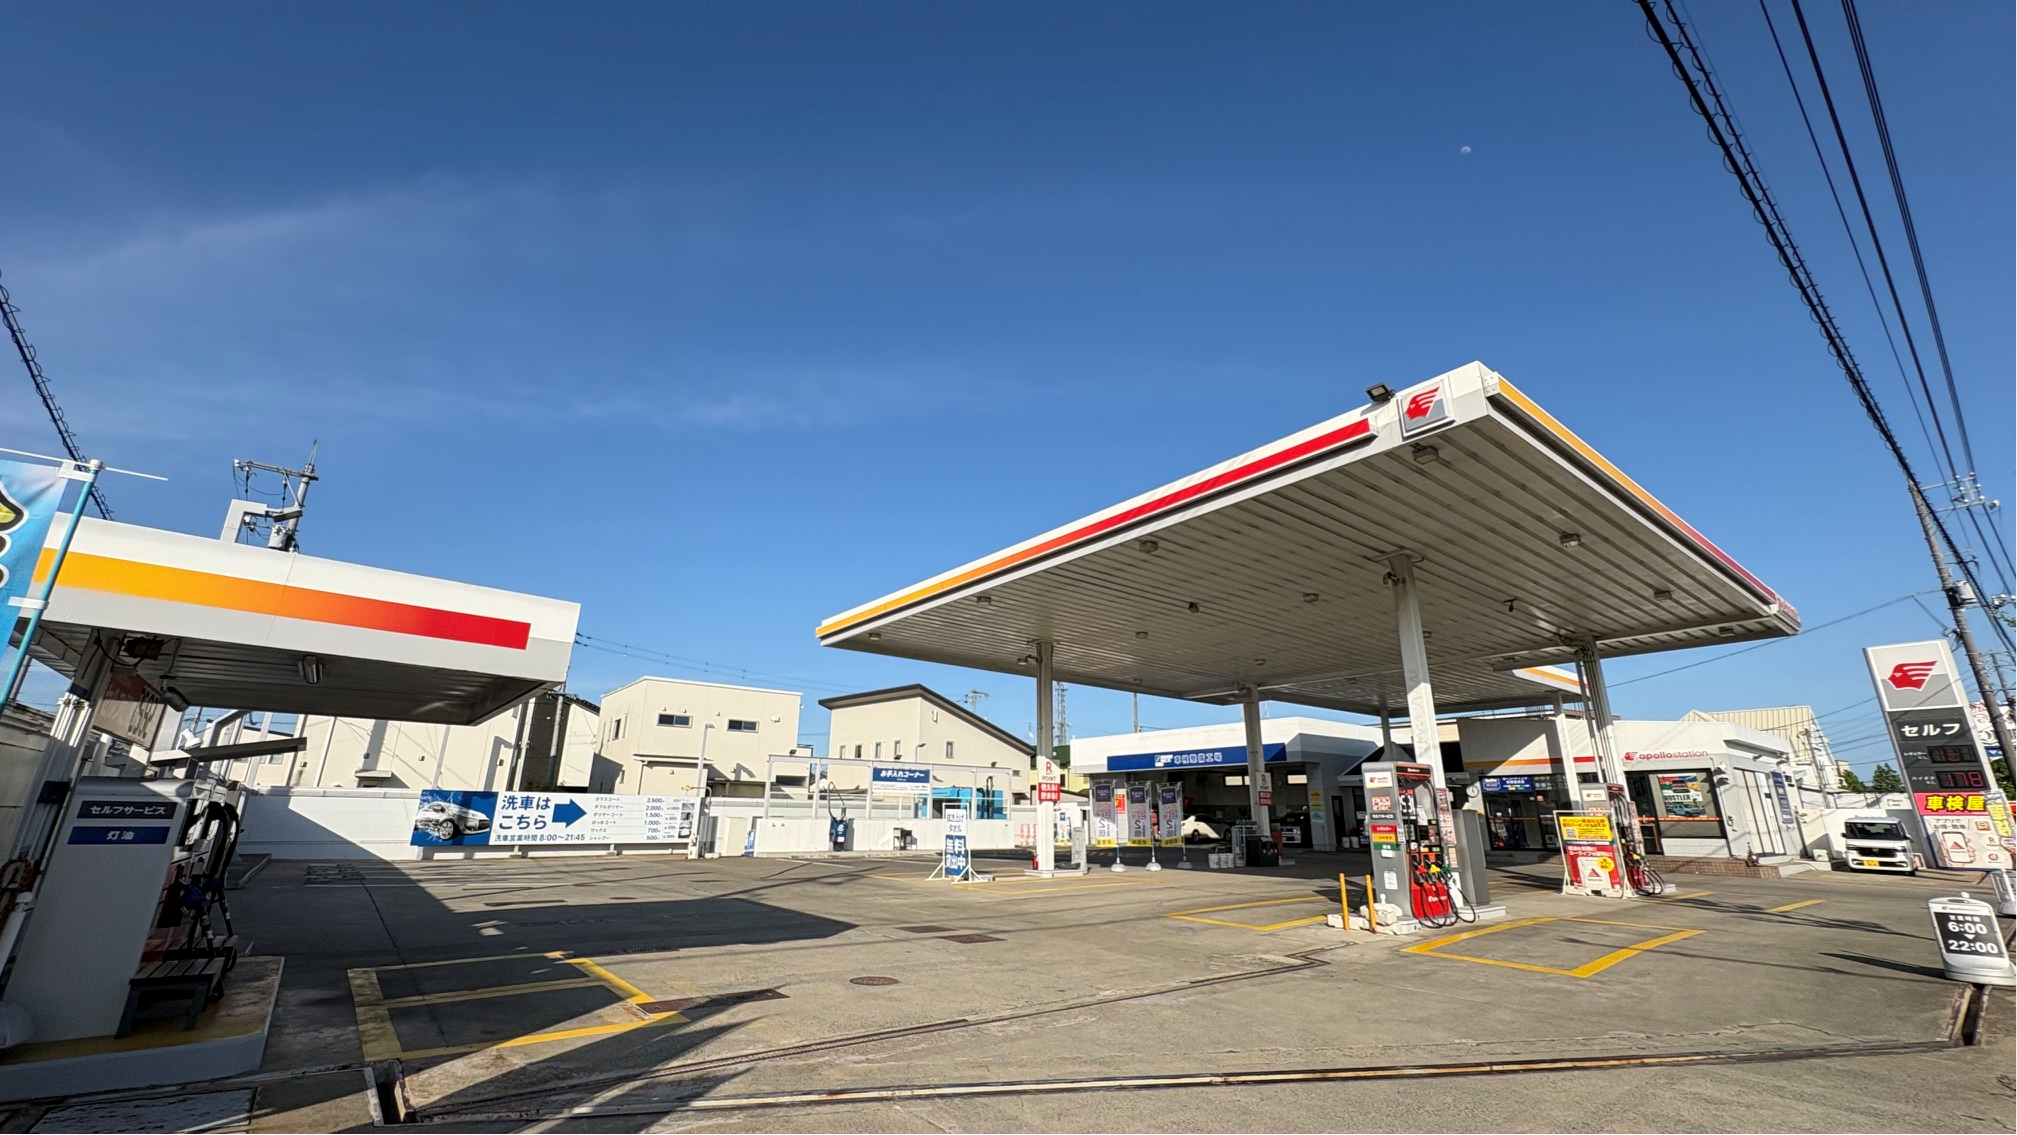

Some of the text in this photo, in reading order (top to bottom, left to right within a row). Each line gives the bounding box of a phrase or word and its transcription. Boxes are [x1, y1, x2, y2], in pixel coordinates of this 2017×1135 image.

[1900, 723, 1960, 737] セルフ
[1639, 750, 1708, 761] apollostation
[880, 770, 925, 778] お手入れコーナー
[1946, 772, 1984, 787] 178
[501, 795, 551, 810] 洗車は
[1925, 795, 1986, 812] 車検屋
[90, 805, 166, 815] セルフサービス
[499, 814, 547, 830] こちら
[106, 830, 135, 840] 灯油
[1948, 921, 1988, 935] 6:00
[1948, 939, 1999, 954] 22:00
